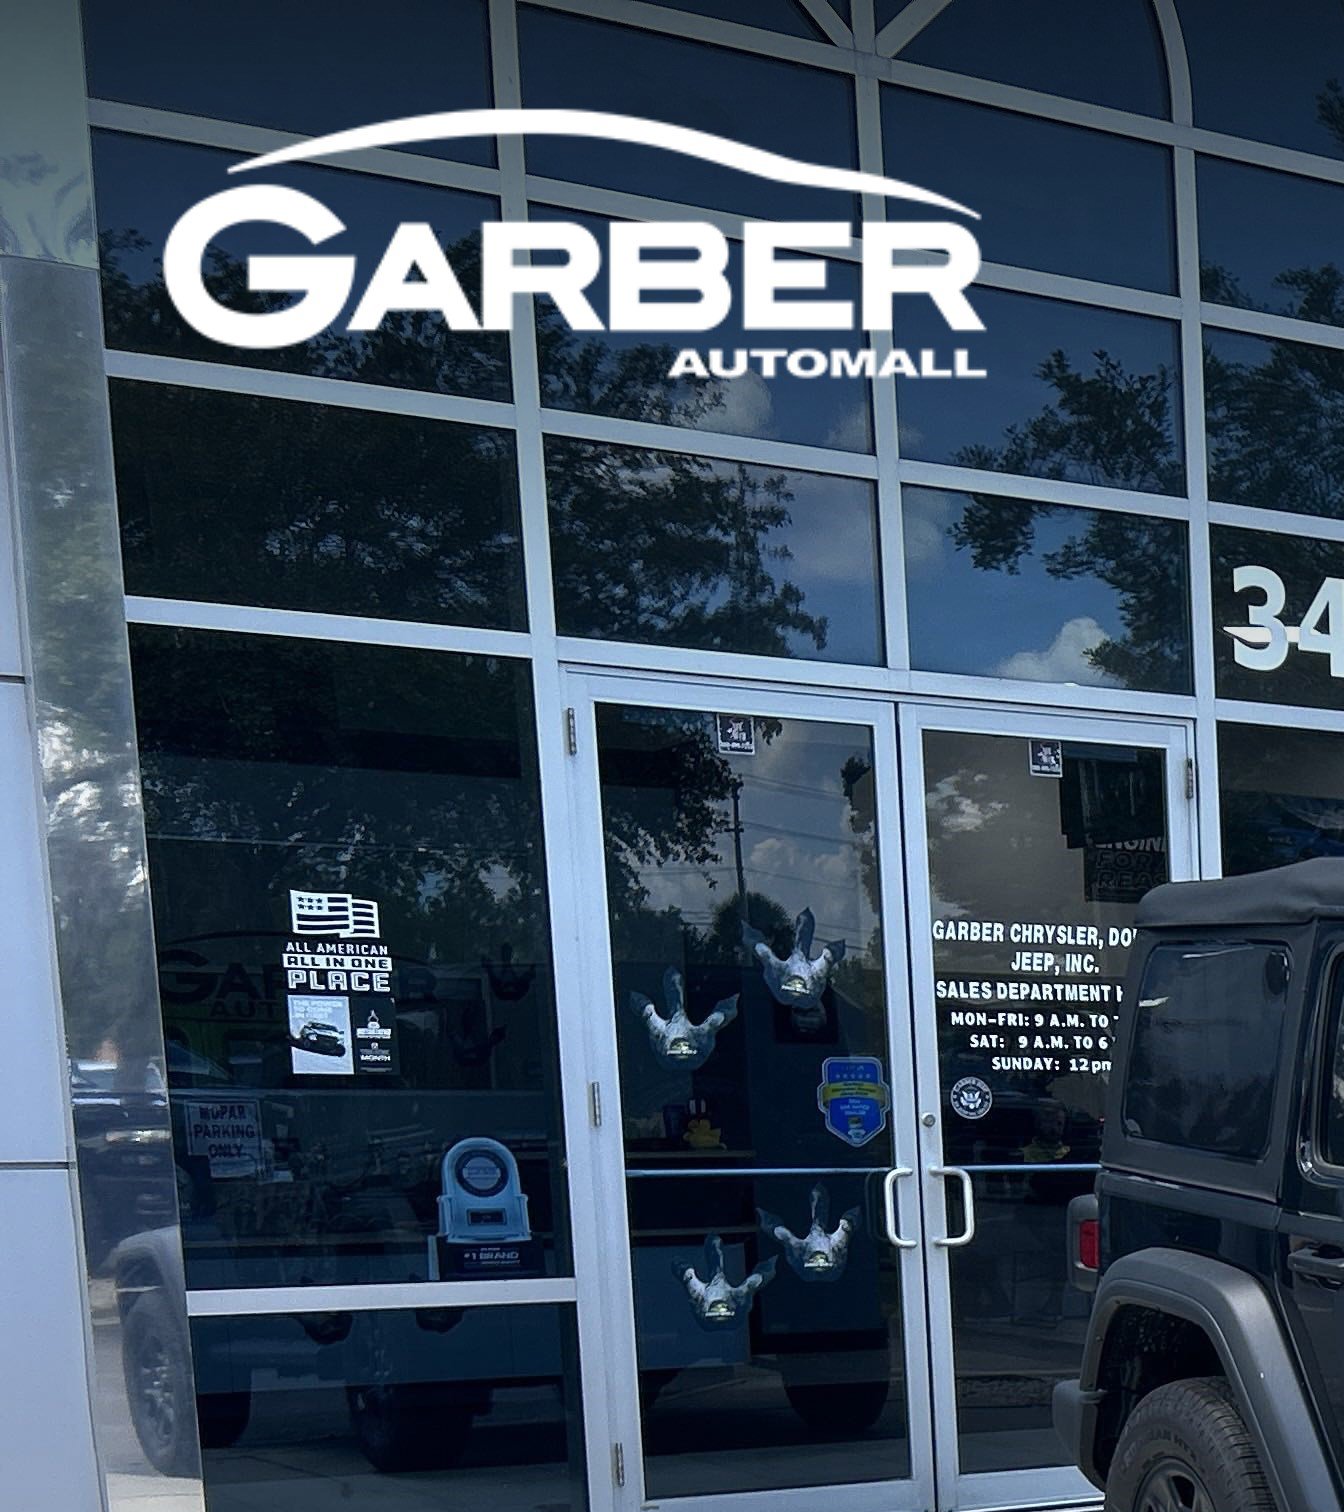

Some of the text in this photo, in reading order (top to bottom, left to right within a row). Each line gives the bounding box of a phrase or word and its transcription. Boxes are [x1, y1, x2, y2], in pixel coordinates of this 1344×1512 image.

[932, 920, 1138, 949] GARBER CHRYSLER, DO
[286, 942, 388, 955] ALL AMERICAN
[287, 956, 388, 968] ALL IN ONE
[1011, 952, 1099, 975] JEEP, INC.
[287, 969, 391, 992] PLACE
[936, 981, 992, 1000] SALES
[997, 983, 1111, 1002] DEPARTMENT
[951, 1012, 1109, 1028] MON-FRI: 9 A.M. TO
[970, 1035, 1108, 1050] SAT: 9 A.M. TO 6
[991, 1056, 1060, 1071] SUNDAY:
[193, 1124, 256, 1138] PARKING
[208, 1144, 244, 1157] ONLY
